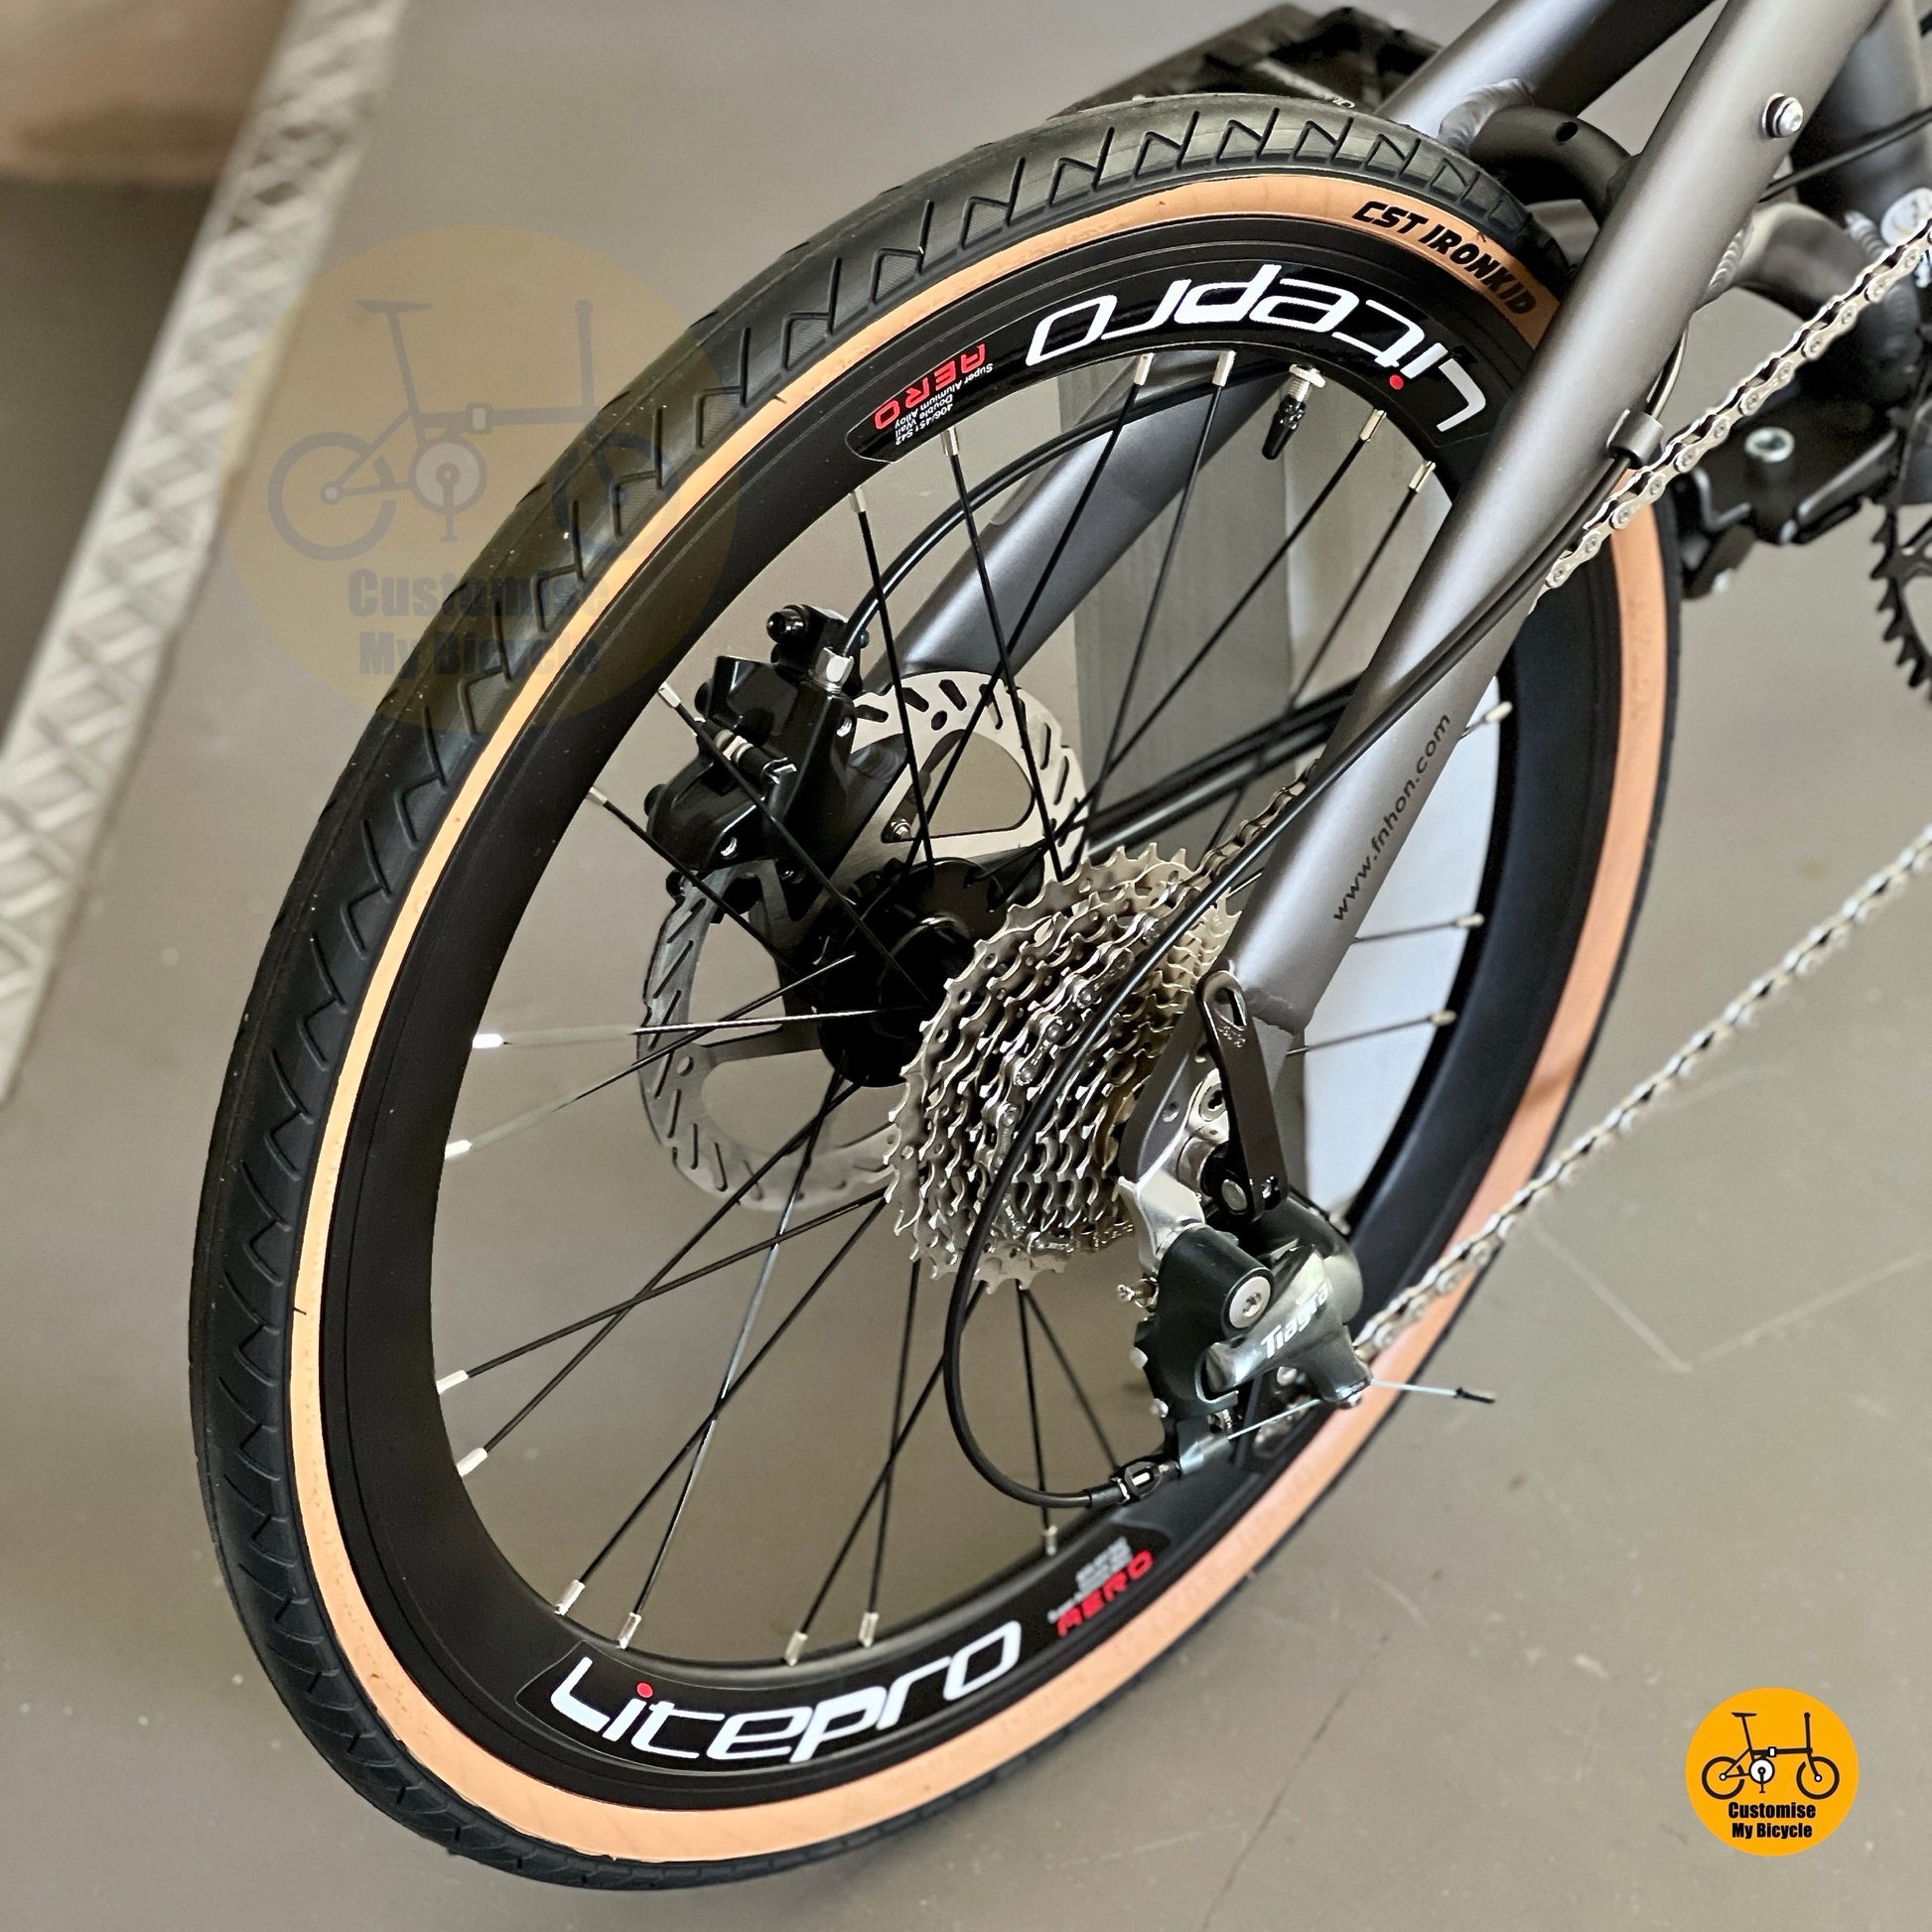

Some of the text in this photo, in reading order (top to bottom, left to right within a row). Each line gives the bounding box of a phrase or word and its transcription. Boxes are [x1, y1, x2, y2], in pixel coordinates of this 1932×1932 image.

[1351, 201, 1537, 314] CST IRONKID
[874, 343, 986, 430] AERO
[964, 363, 994, 384] Super
[1026, 264, 1486, 432] Litepro
[895, 408, 918, 429] Alloy
[896, 394, 953, 438] Double Wall
[1333, 714, 1450, 920] www.fnhon.com
[1260, 1283, 1328, 1359] Tiagra
[1057, 1550, 1153, 1637] AERO
[551, 1620, 1022, 1763] Litepro
